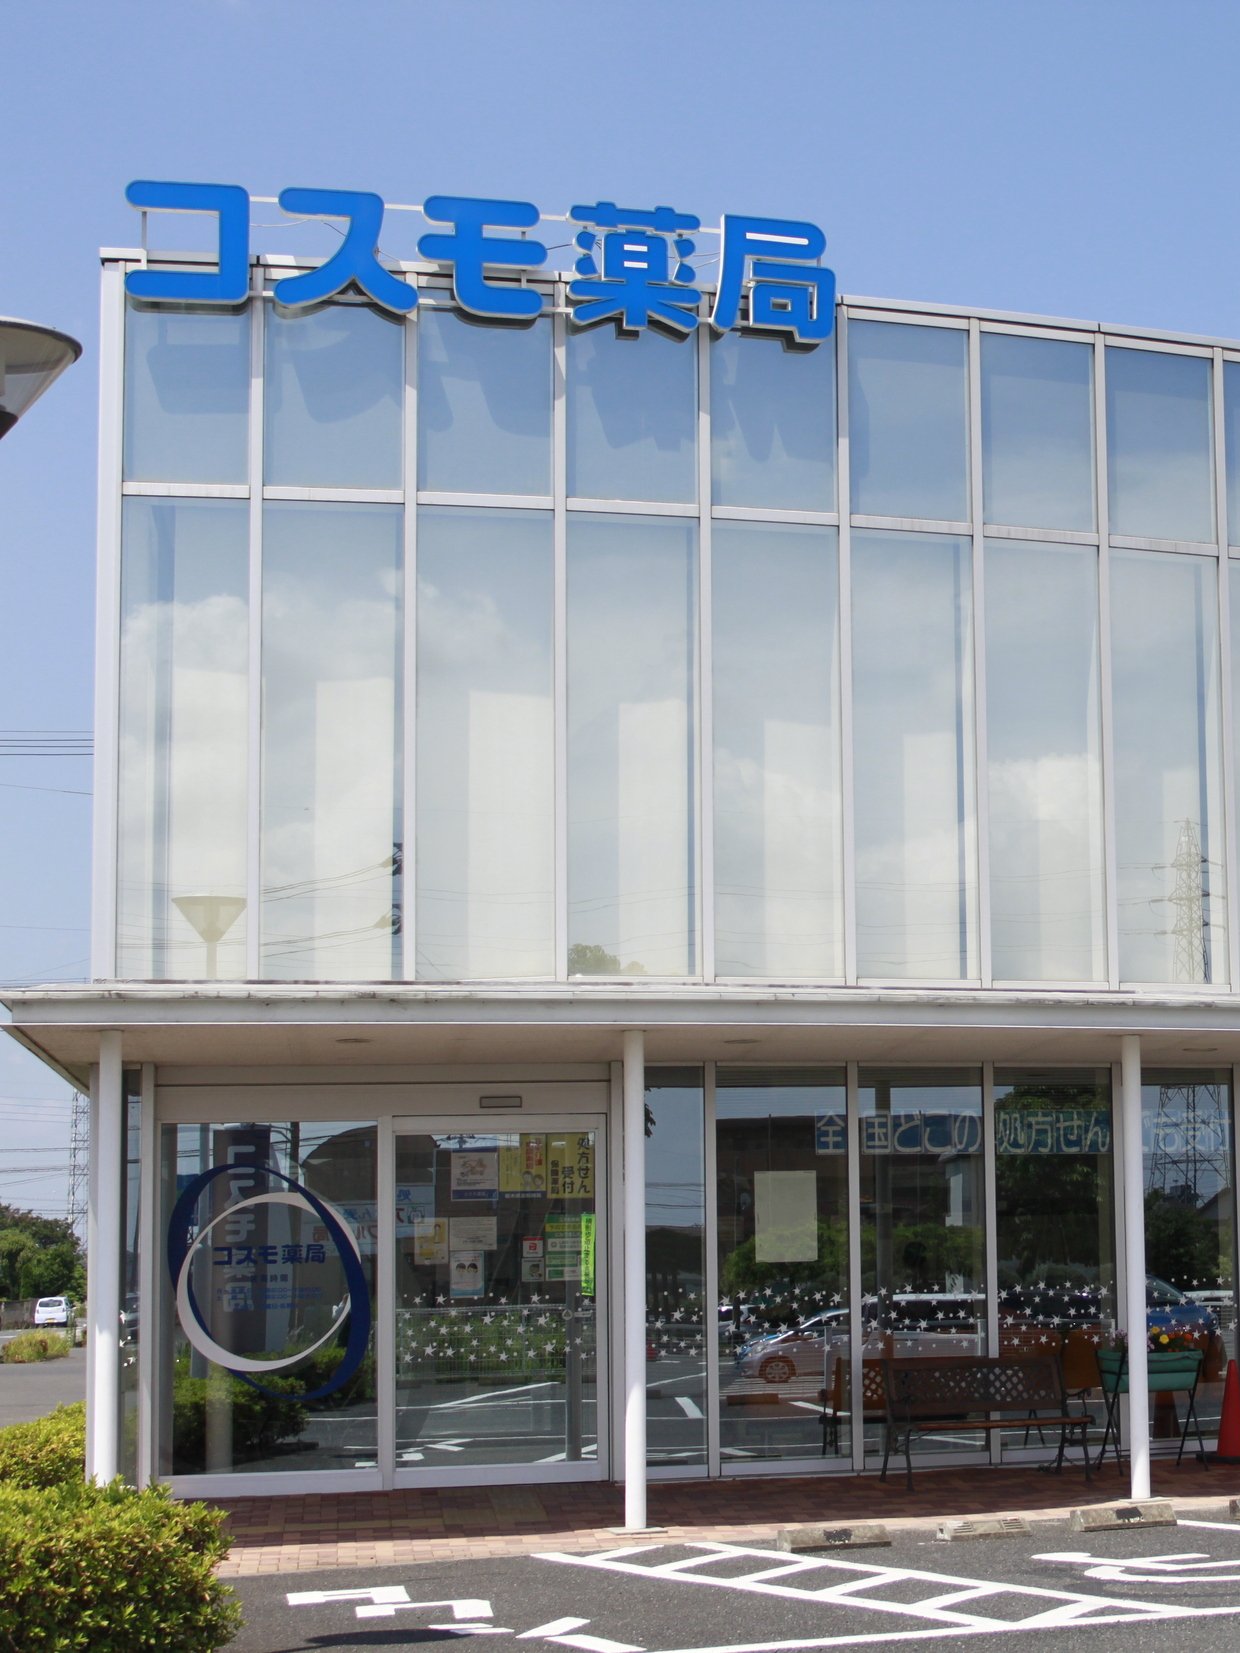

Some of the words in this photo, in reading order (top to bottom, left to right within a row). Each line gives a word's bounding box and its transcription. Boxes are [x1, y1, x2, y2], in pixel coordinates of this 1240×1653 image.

[125, 180, 836, 343] コスモ薬局
[561, 1166, 575, 1194] 受付
[576, 1136, 591, 1194] 処方せん
[213, 1244, 326, 1266] コスモ薬局
